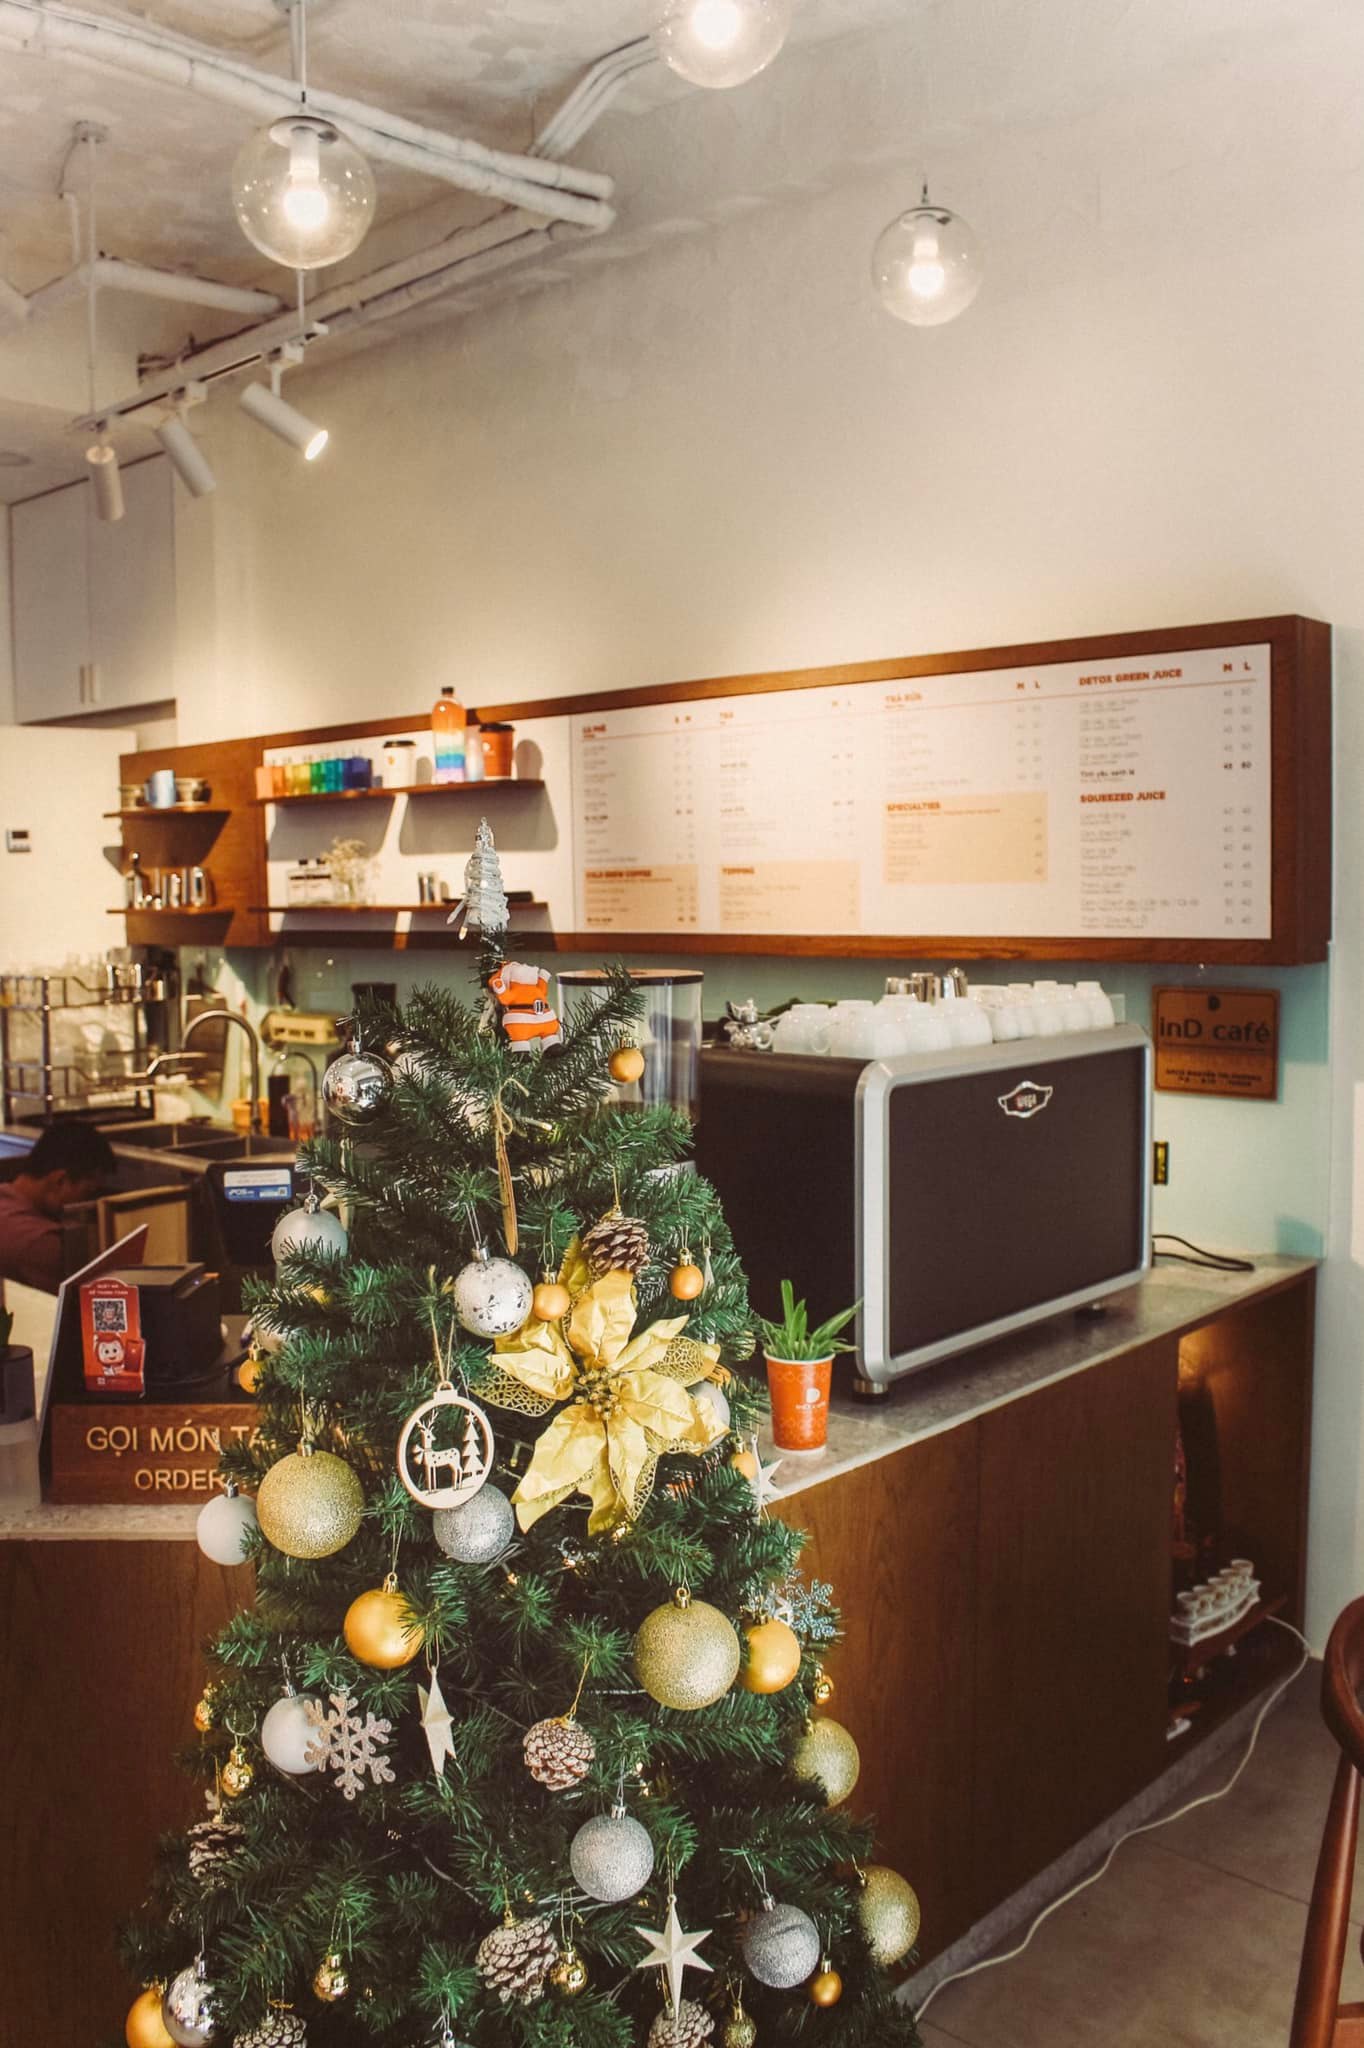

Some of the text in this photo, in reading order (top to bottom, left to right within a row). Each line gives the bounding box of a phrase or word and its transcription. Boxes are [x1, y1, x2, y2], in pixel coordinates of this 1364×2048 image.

[1152, 668, 1183, 679] JUICE
[1136, 791, 1167, 801] JUICE
[1212, 1020, 1270, 1043] café
[86, 1426, 138, 1457] GỌI
[150, 1419, 220, 1452] MÓN
[134, 1469, 225, 1490] ORDER
